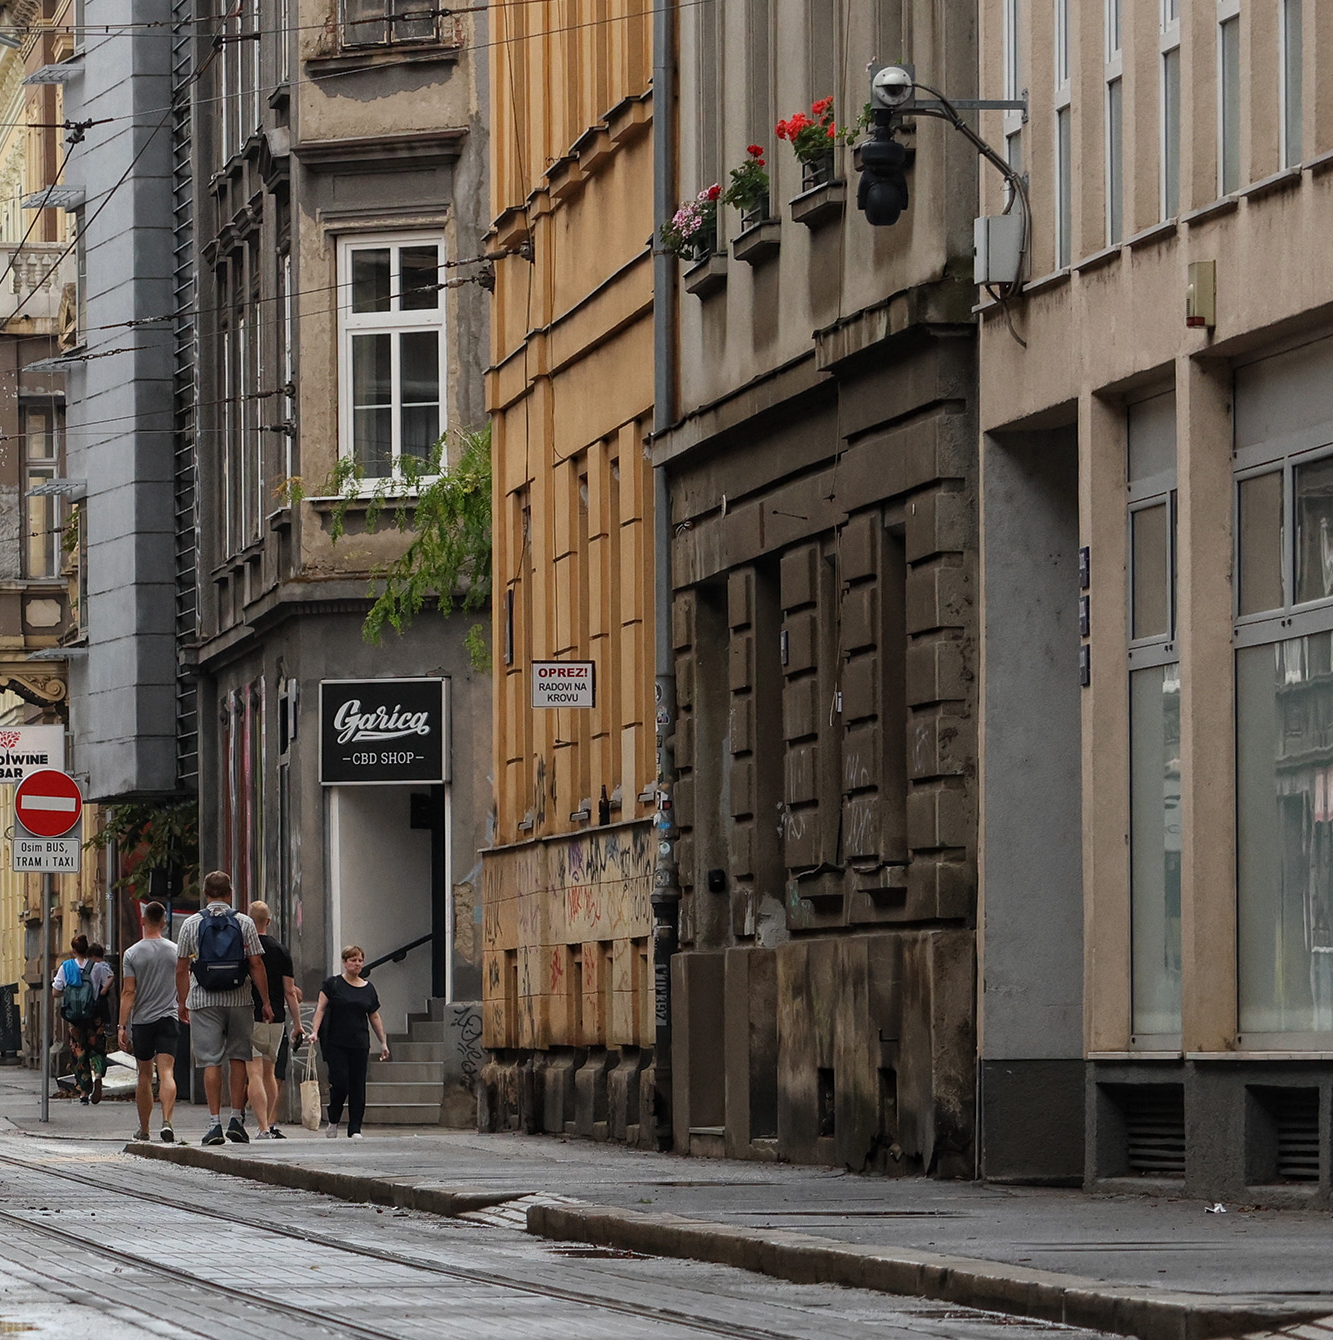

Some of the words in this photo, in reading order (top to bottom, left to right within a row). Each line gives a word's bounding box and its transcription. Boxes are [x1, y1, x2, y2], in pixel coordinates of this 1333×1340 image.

[538, 667, 588, 678] OPREZ!
[539, 682, 572, 692] RADOVI
[574, 682, 587, 691] NA
[547, 693, 579, 702] KROVU
[334, 699, 430, 744] Garica
[352, 752, 377, 765] CBD
[380, 751, 414, 765] SHOP
[21, 842, 42, 853] Osim
[46, 842, 68, 854] BUS,
[16, 857, 42, 867] TRAM
[52, 857, 74, 867] TAXI
